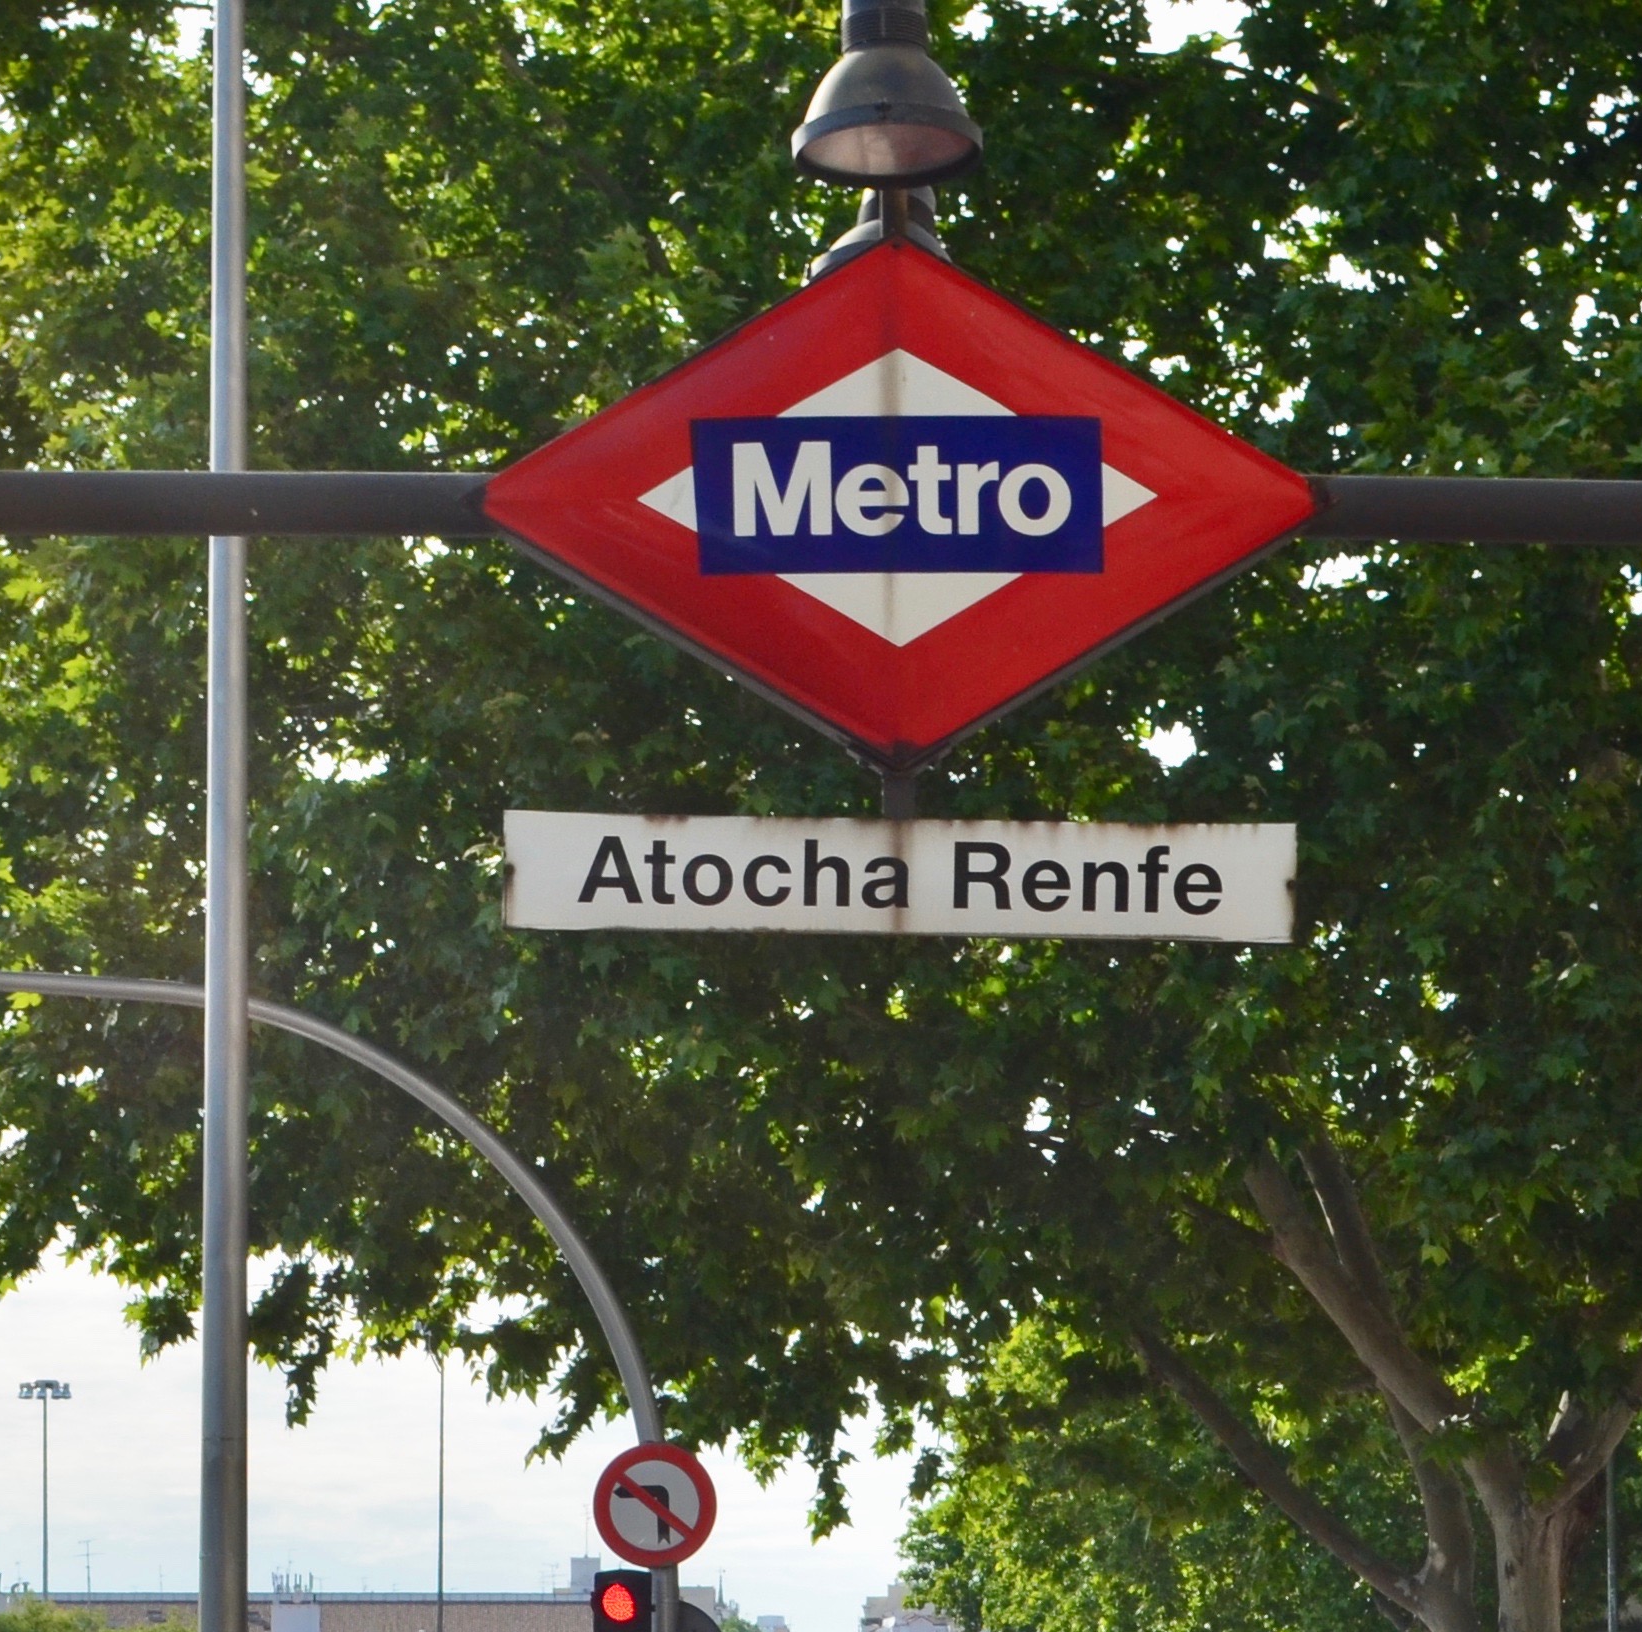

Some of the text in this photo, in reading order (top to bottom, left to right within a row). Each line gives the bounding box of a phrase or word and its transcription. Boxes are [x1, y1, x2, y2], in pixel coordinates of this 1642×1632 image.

[732, 440, 1072, 538] Metro
[578, 835, 1224, 916] Atocha Renfe
